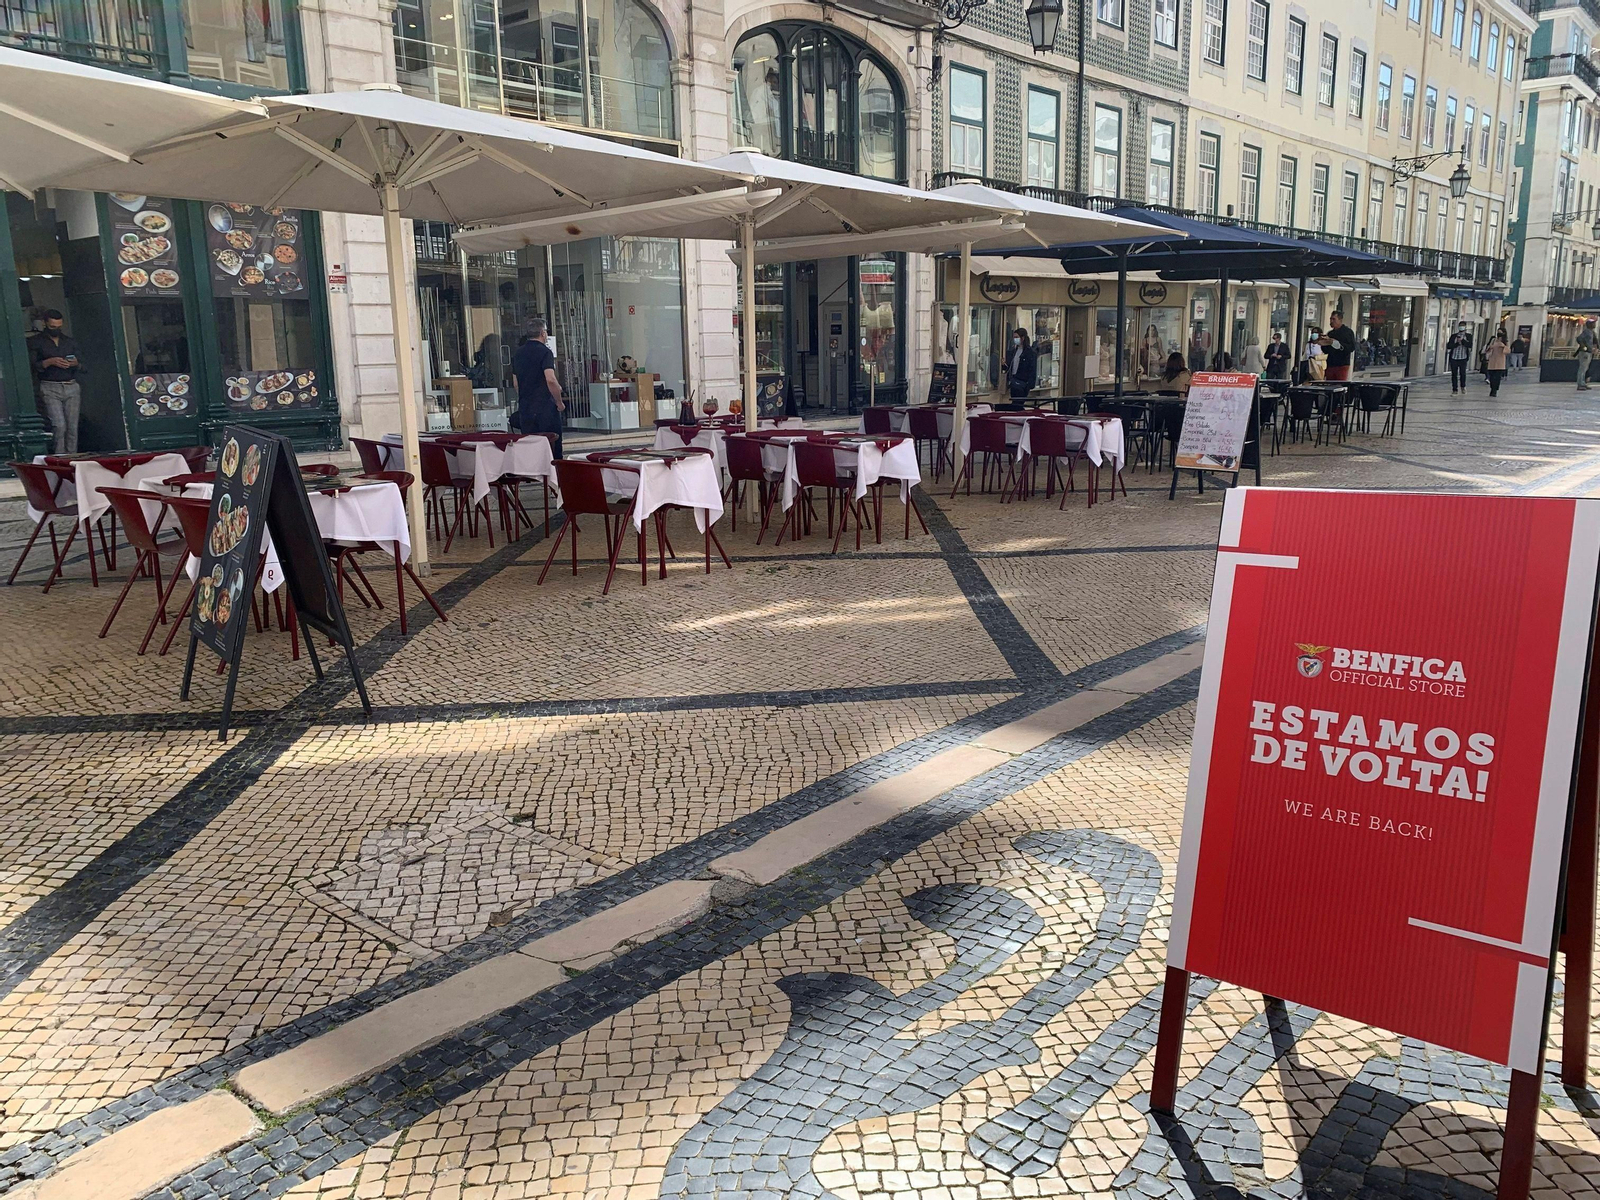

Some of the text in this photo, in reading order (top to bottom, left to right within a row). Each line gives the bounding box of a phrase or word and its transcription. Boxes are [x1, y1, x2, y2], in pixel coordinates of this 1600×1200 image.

[1208, 375, 1239, 383] BRUNCH
[1330, 670, 1466, 698] OFFICIAL STORE
[1331, 647, 1467, 683] BENFICA
[1250, 700, 1496, 766] ESTAMOS
[1250, 734, 1490, 803] DE VOLTA!
[1284, 799, 1434, 842] WE ARE BACK!
